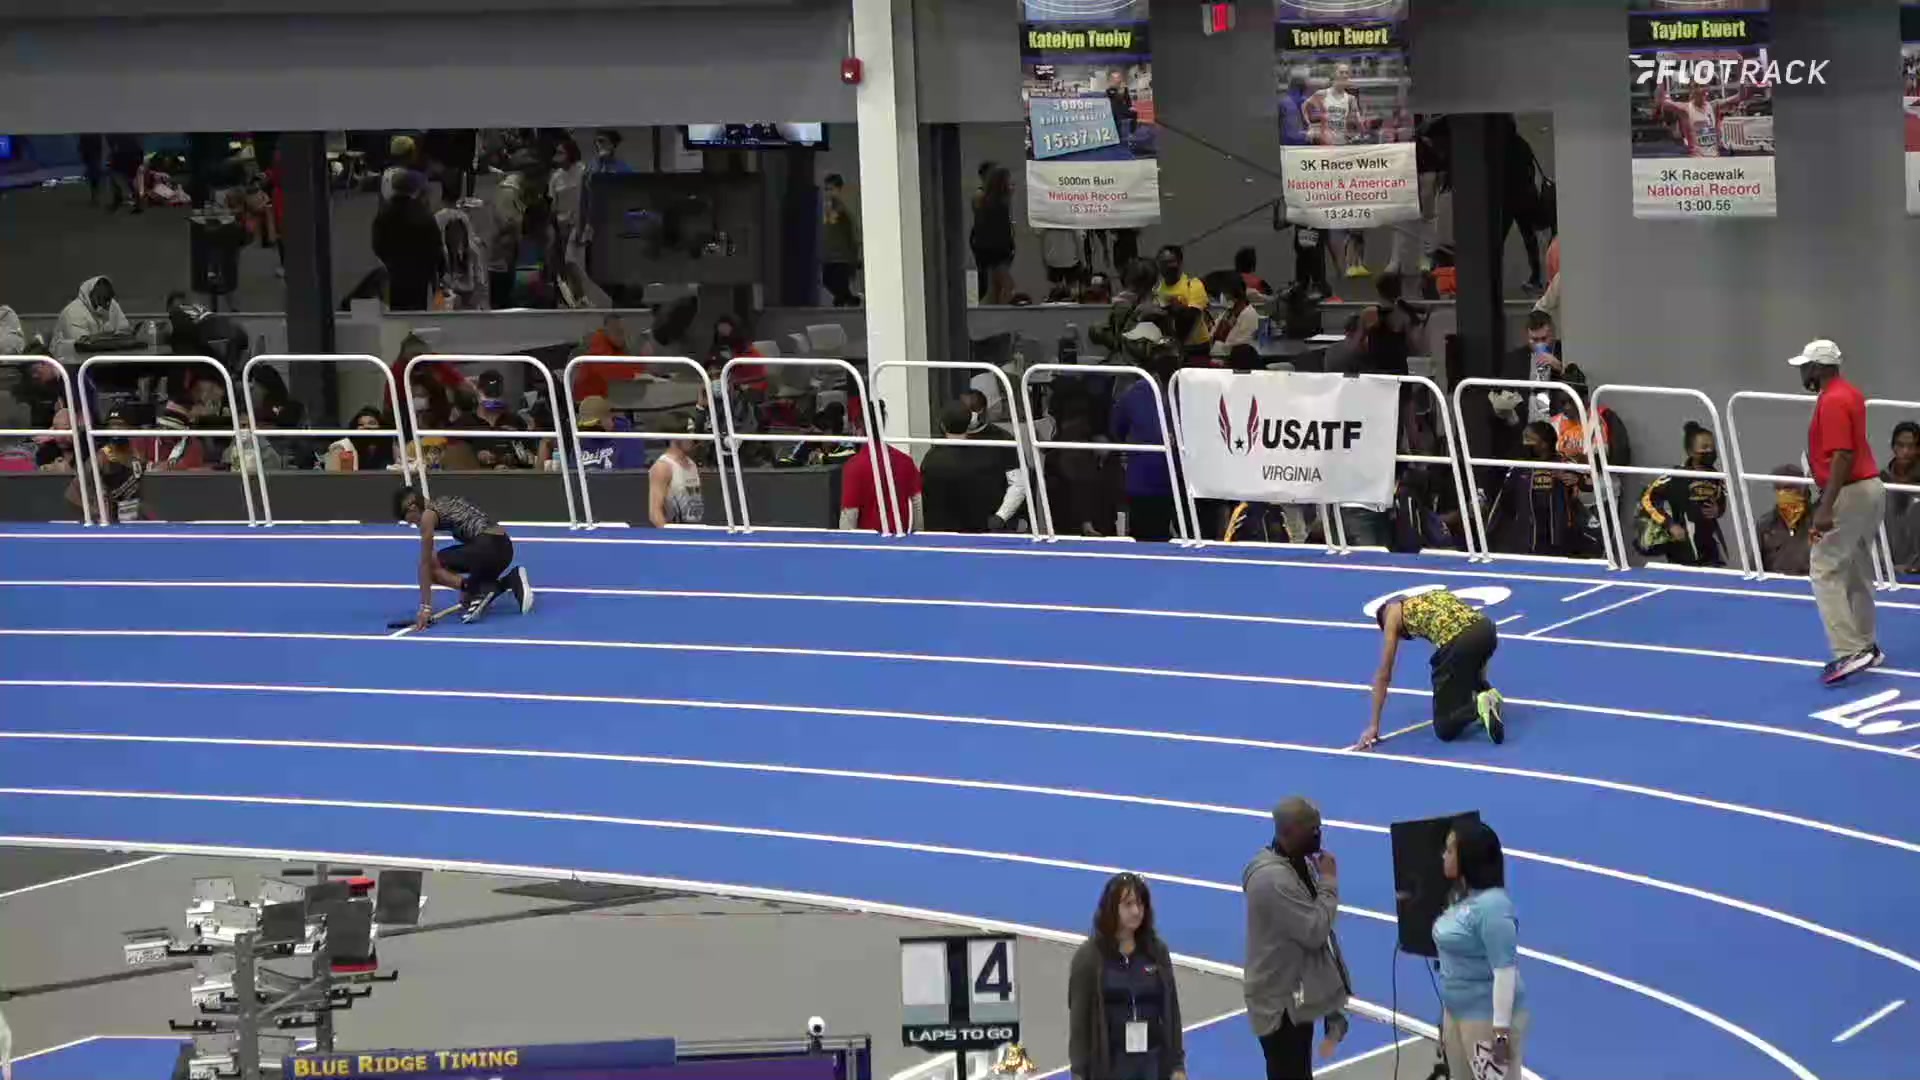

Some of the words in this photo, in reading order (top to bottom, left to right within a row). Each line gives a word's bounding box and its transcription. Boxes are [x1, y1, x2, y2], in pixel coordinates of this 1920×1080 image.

[1292, 28, 1341, 47] Taylor
[1343, 27, 1389, 45] Ewert
[1651, 20, 1700, 40] Taylor
[1702, 20, 1746, 38] Ewert
[1028, 31, 1085, 49] Katelyn
[1088, 29, 1131, 48] Tuohy
[1300, 159, 1317, 171] 3K
[1321, 158, 1353, 170] Race
[1356, 158, 1388, 169] Walk
[1058, 176, 1091, 186] 5000m
[1093, 176, 1114, 185] Run
[1660, 169, 1677, 181] 3K
[1682, 168, 1745, 181] Racewalk
[1287, 179, 1333, 190] National
[1337, 180, 1345, 189] &
[1349, 178, 1406, 189] American
[1647, 184, 1704, 197] National
[1709, 183, 1761, 196] Record
[1048, 191, 1088, 200] National
[1091, 191, 1128, 200] Record
[1305, 190, 1341, 202] Junior
[1345, 189, 1388, 201] Record
[1677, 199, 1731, 212] 13:00.56
[1325, 208, 1371, 220] 13:24.76
[1263, 419, 1362, 450] USATF
[1262, 465, 1322, 482] VIRGINIA
[974, 942, 1012, 1001] 4
[909, 1029, 957, 1042] LAPS
[960, 1029, 985, 1041] TO
[987, 1027, 1013, 1040] GO
[294, 1058, 349, 1077] BLUE
[358, 1055, 428, 1073] RIDGE
[434, 1050, 519, 1070] TIMING
